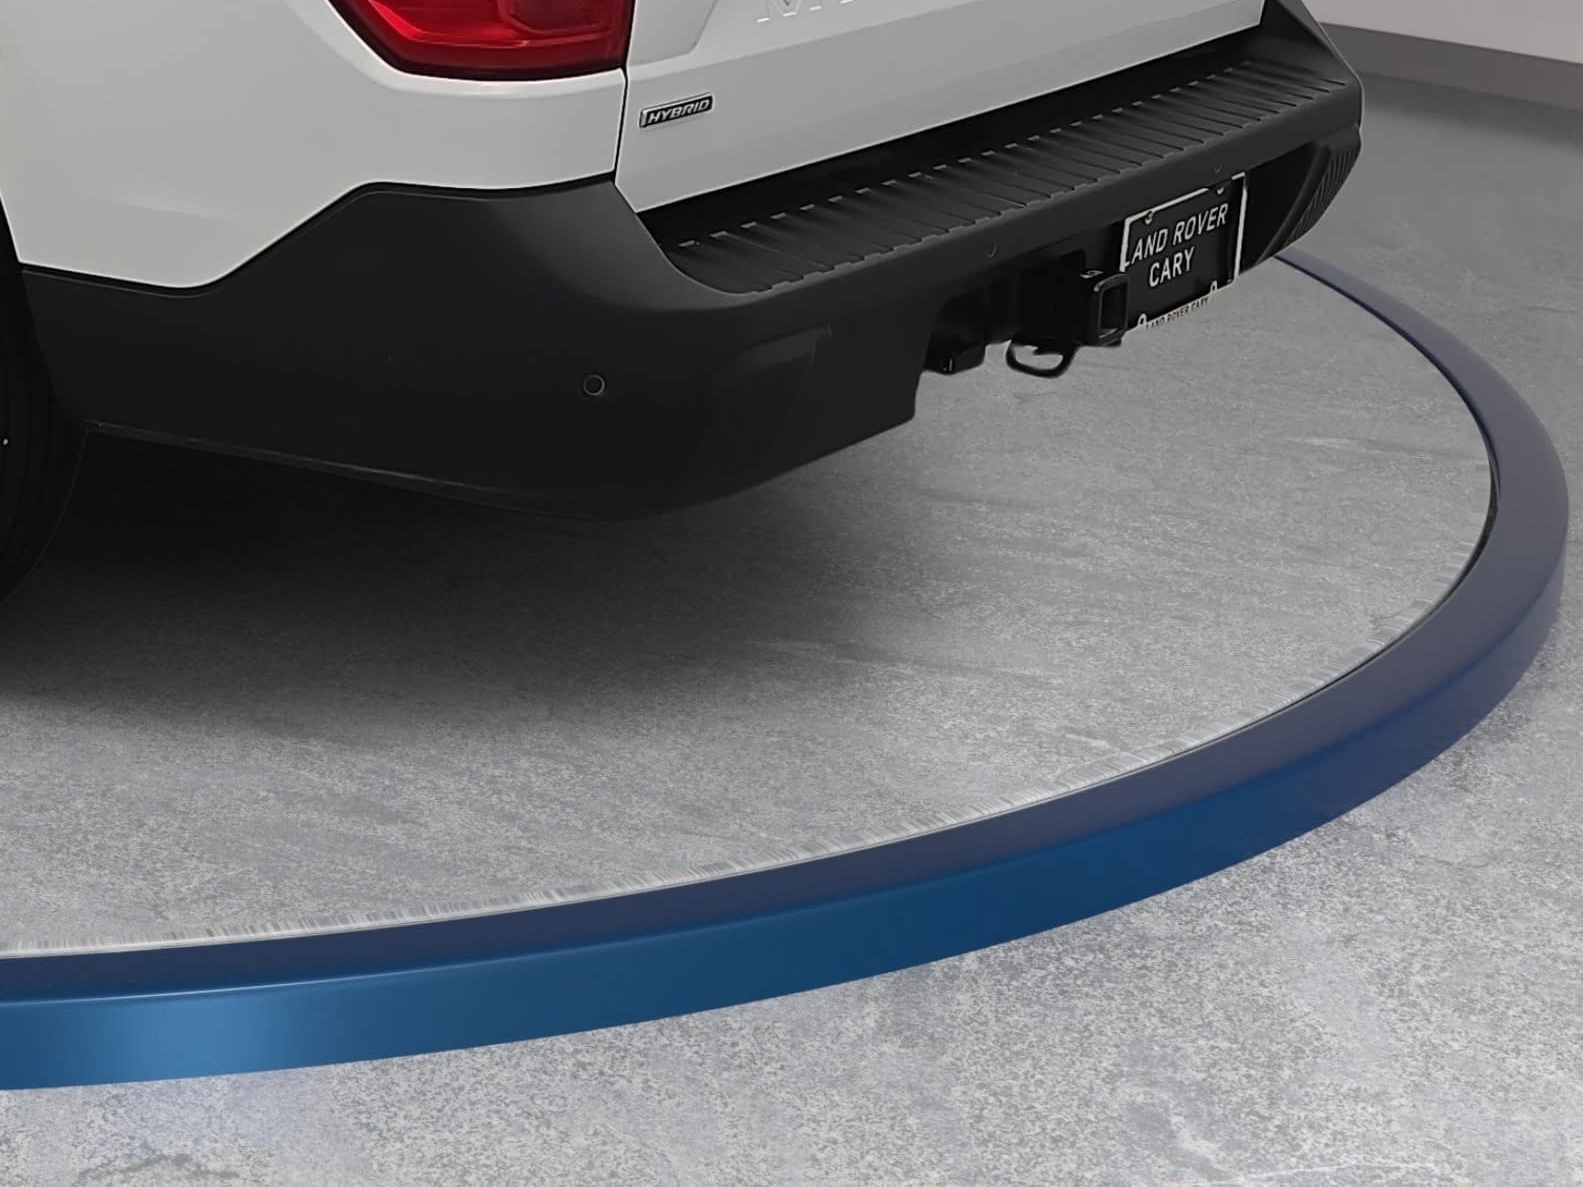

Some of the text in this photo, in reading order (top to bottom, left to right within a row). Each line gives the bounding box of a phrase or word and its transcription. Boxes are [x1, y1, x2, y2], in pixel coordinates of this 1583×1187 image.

[647, 99, 711, 124] HYBRID
[1172, 203, 1229, 247] ROVER
[1148, 246, 1195, 287] CARY
